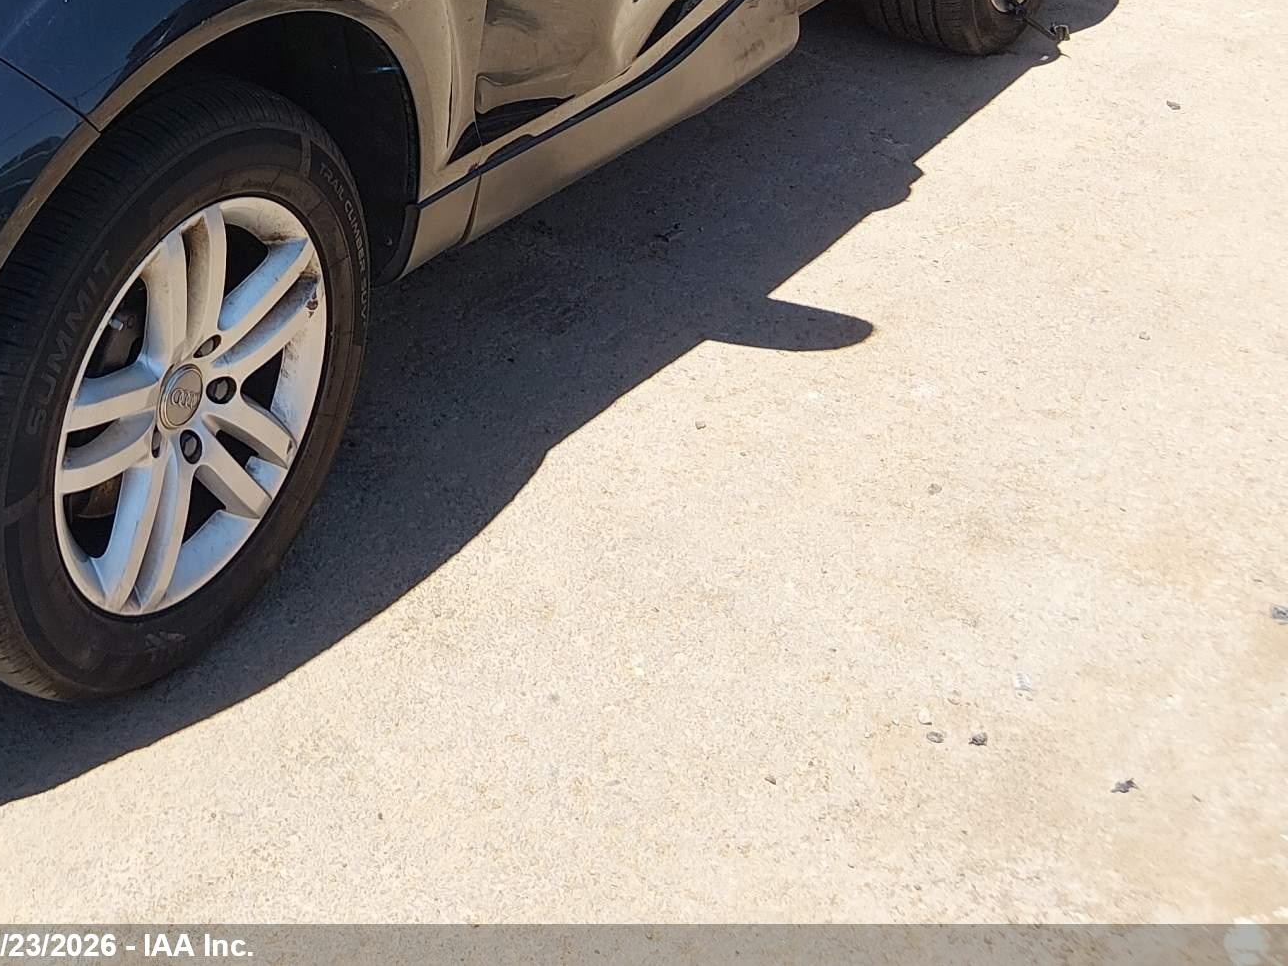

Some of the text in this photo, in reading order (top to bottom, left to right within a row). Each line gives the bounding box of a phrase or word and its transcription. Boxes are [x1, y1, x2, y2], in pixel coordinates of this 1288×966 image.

[319, 162, 345, 202] TRAIL
[344, 199, 366, 273] CLIMBER
[25, 249, 111, 435] SUMMIT
